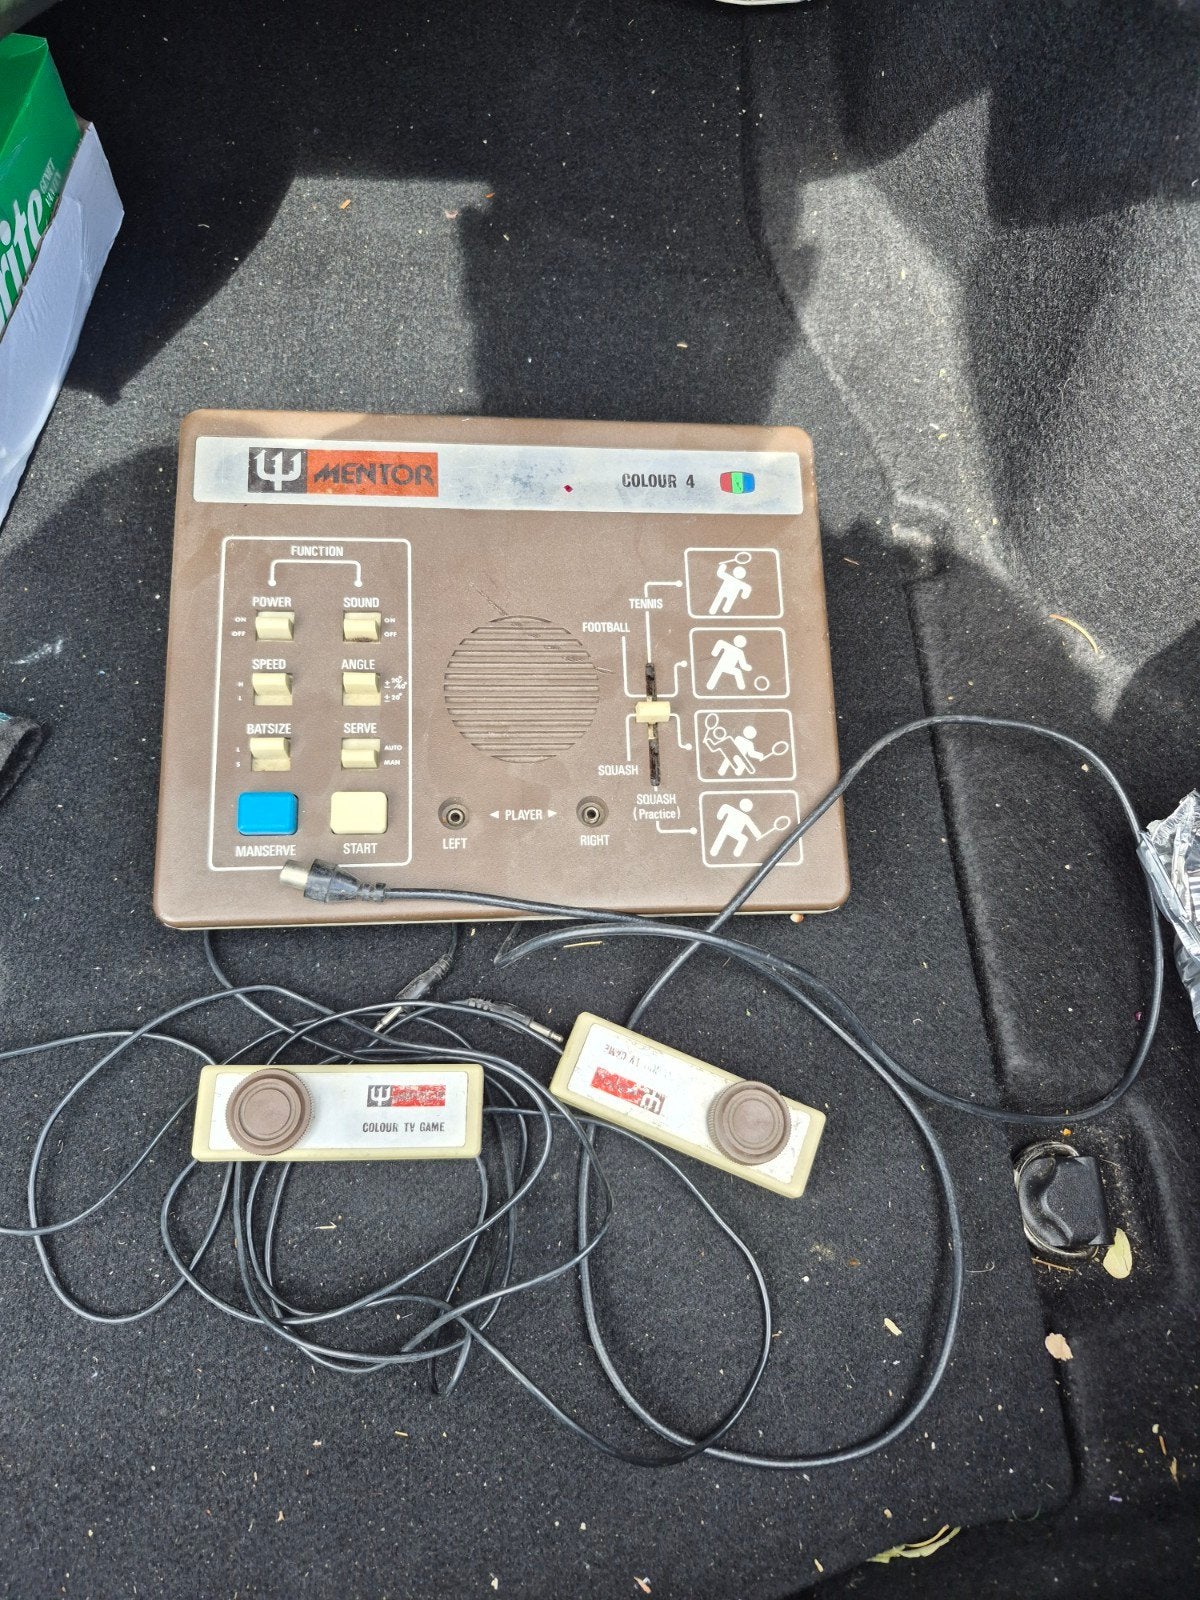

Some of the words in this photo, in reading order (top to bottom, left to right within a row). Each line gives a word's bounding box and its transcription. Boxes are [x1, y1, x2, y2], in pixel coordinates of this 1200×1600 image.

[0, 189, 43, 335] rite
[313, 462, 435, 487] MENTOR
[622, 473, 677, 488] COLOUR
[686, 474, 695, 488] 4
[290, 545, 344, 557] FUNCTION
[252, 597, 292, 608] POWER
[343, 597, 380, 608] SOUND
[629, 598, 663, 609] TENNIS
[582, 621, 630, 633] FOOTBALL
[252, 659, 287, 670] SPEED
[341, 659, 376, 670] ANGLE
[246, 723, 292, 735] BATSIZE
[343, 722, 378, 734] SERVE
[598, 764, 639, 776] SQUASH
[636, 793, 677, 805] SQUASH
[505, 809, 543, 821] PLAYER
[633, 806, 681, 821] (Practice)
[442, 838, 468, 850] LEFT
[580, 834, 610, 846] RIGHT
[235, 844, 297, 857] MANSERVE
[343, 842, 378, 855] START
[362, 1122, 399, 1133] COLOUR
[404, 1122, 416, 1132] TV
[420, 1121, 446, 1132] GAME
